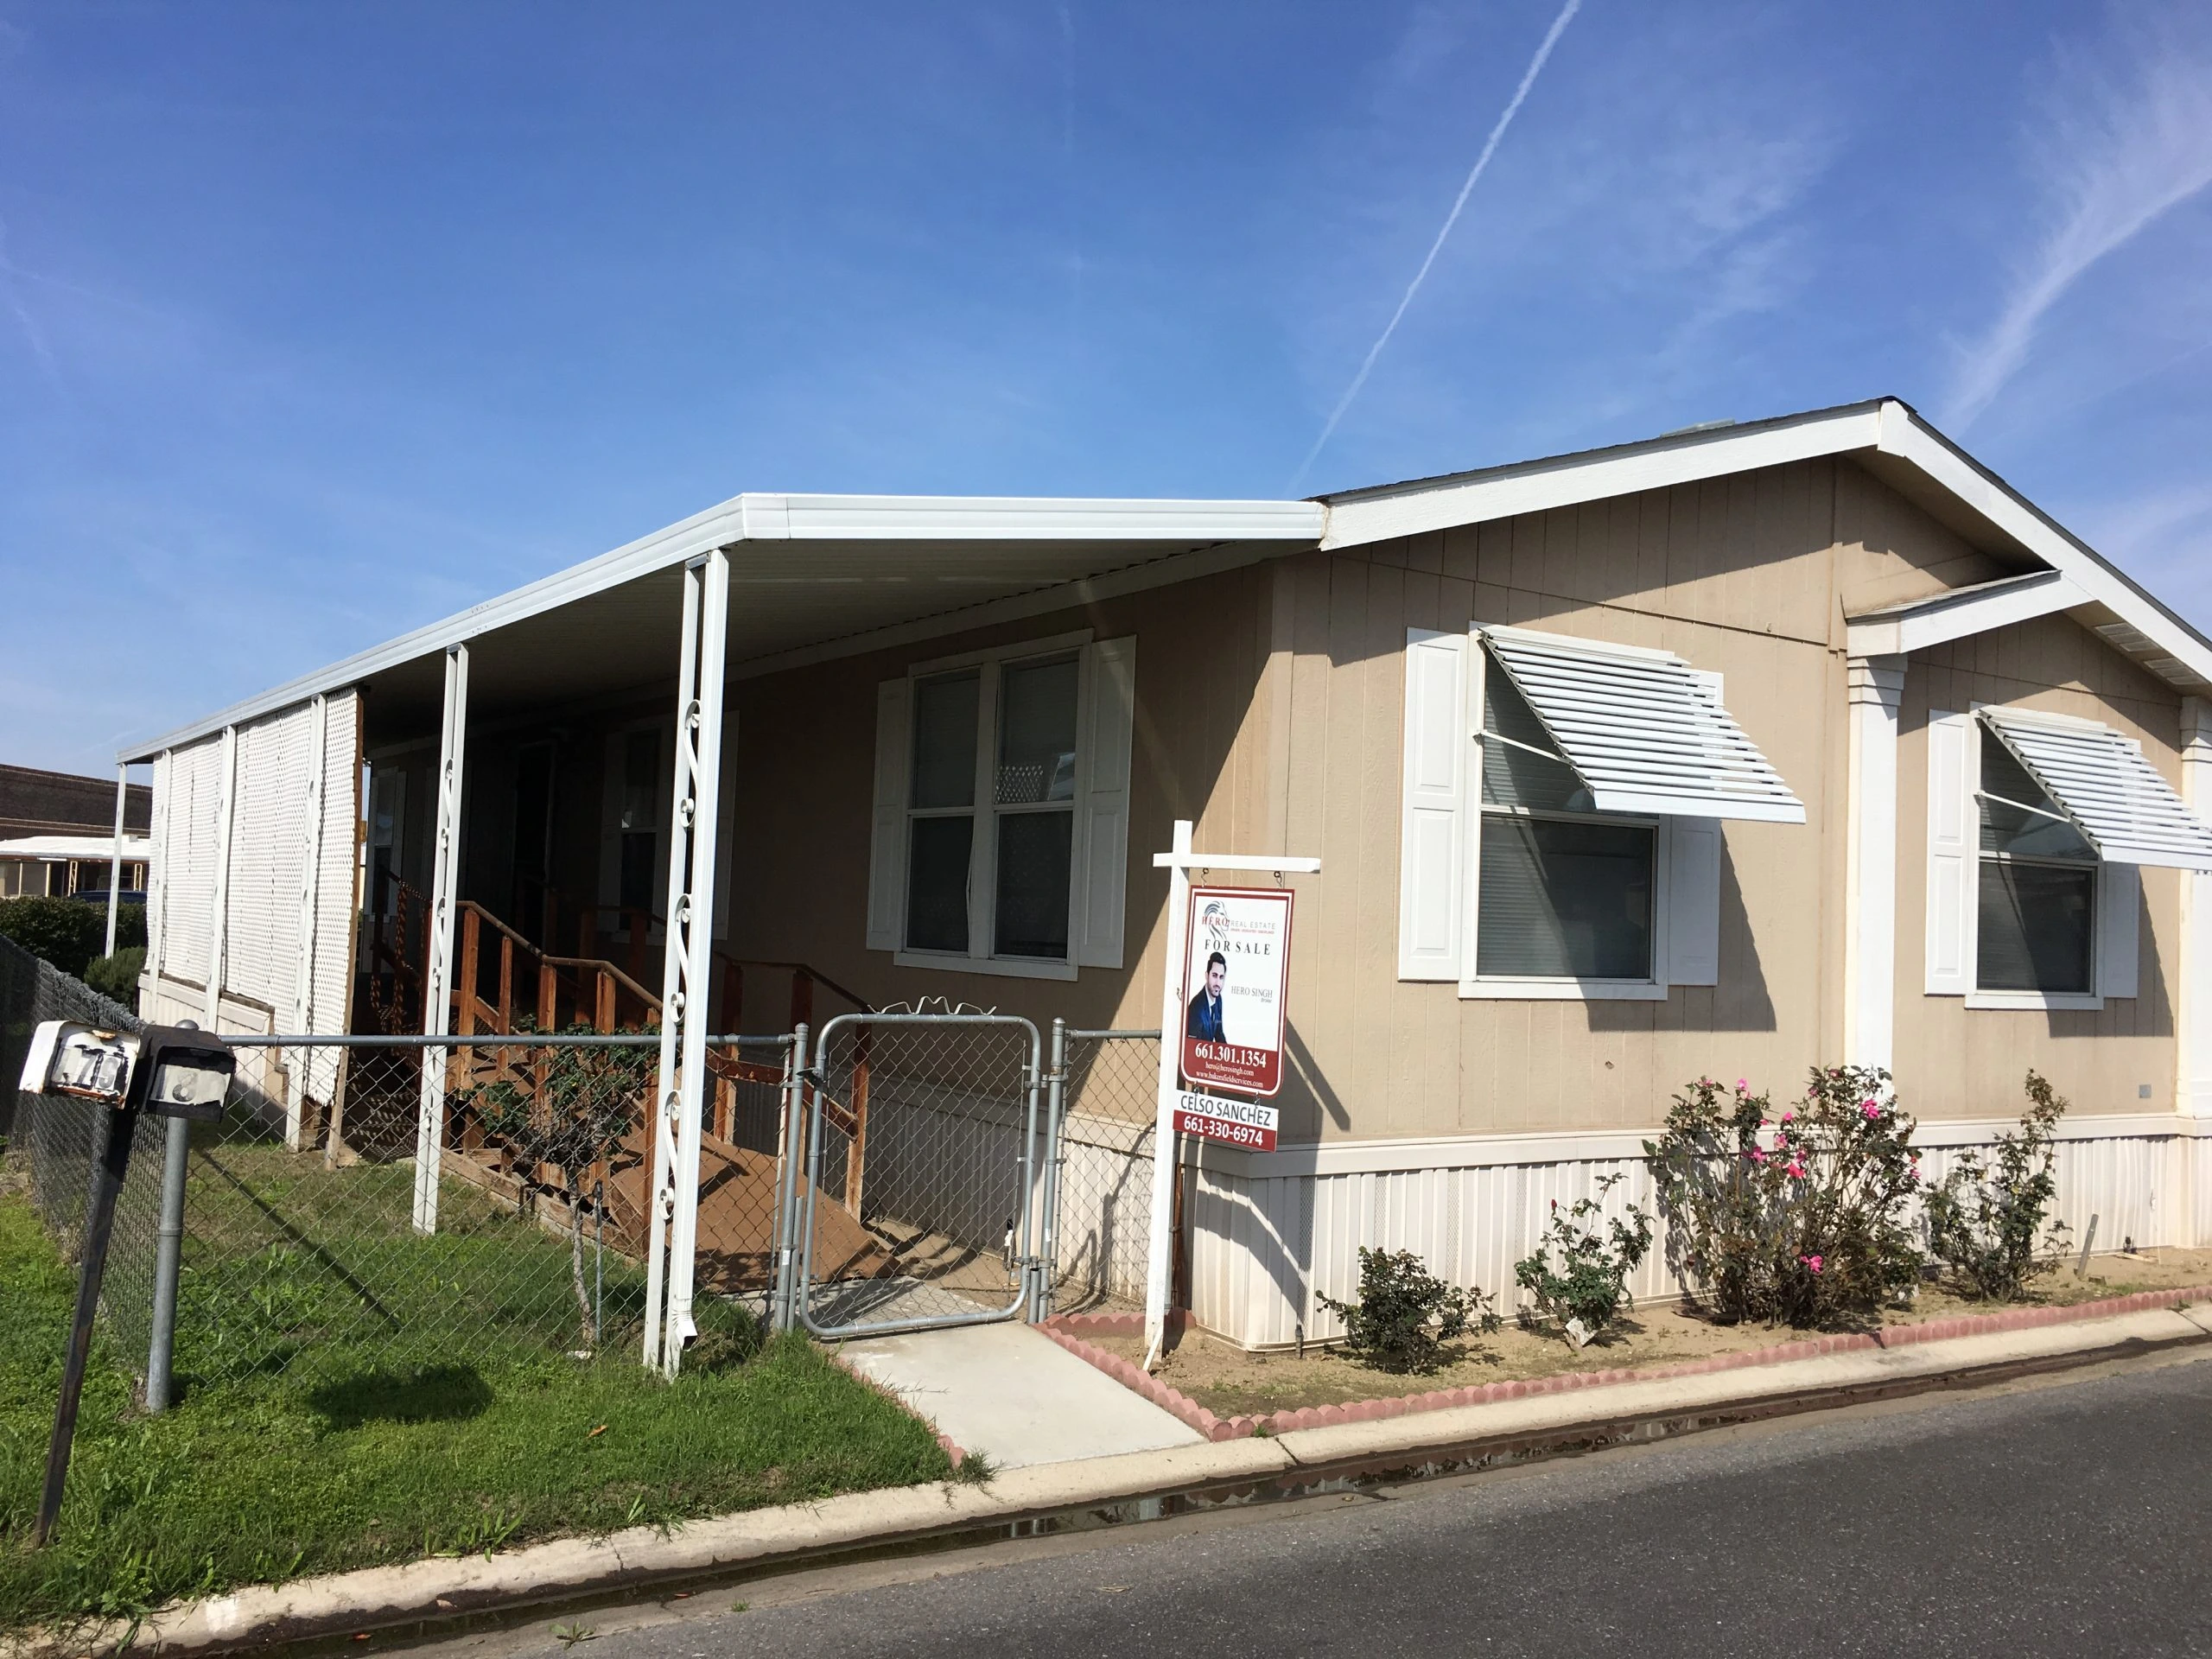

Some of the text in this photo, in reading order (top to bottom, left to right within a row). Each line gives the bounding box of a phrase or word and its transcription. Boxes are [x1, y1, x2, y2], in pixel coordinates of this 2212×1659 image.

[1202, 916, 1230, 926] HERO
[1250, 921, 1275, 930] ESTATE
[1205, 939, 1270, 956] FOR SALE
[1231, 986, 1273, 999] HERO SINGH
[1195, 1043, 1266, 1068] 661.301.1354
[1180, 1095, 1271, 1126] CELSO SANCHEZ
[1184, 1116, 1263, 1146] 661-330-6974
